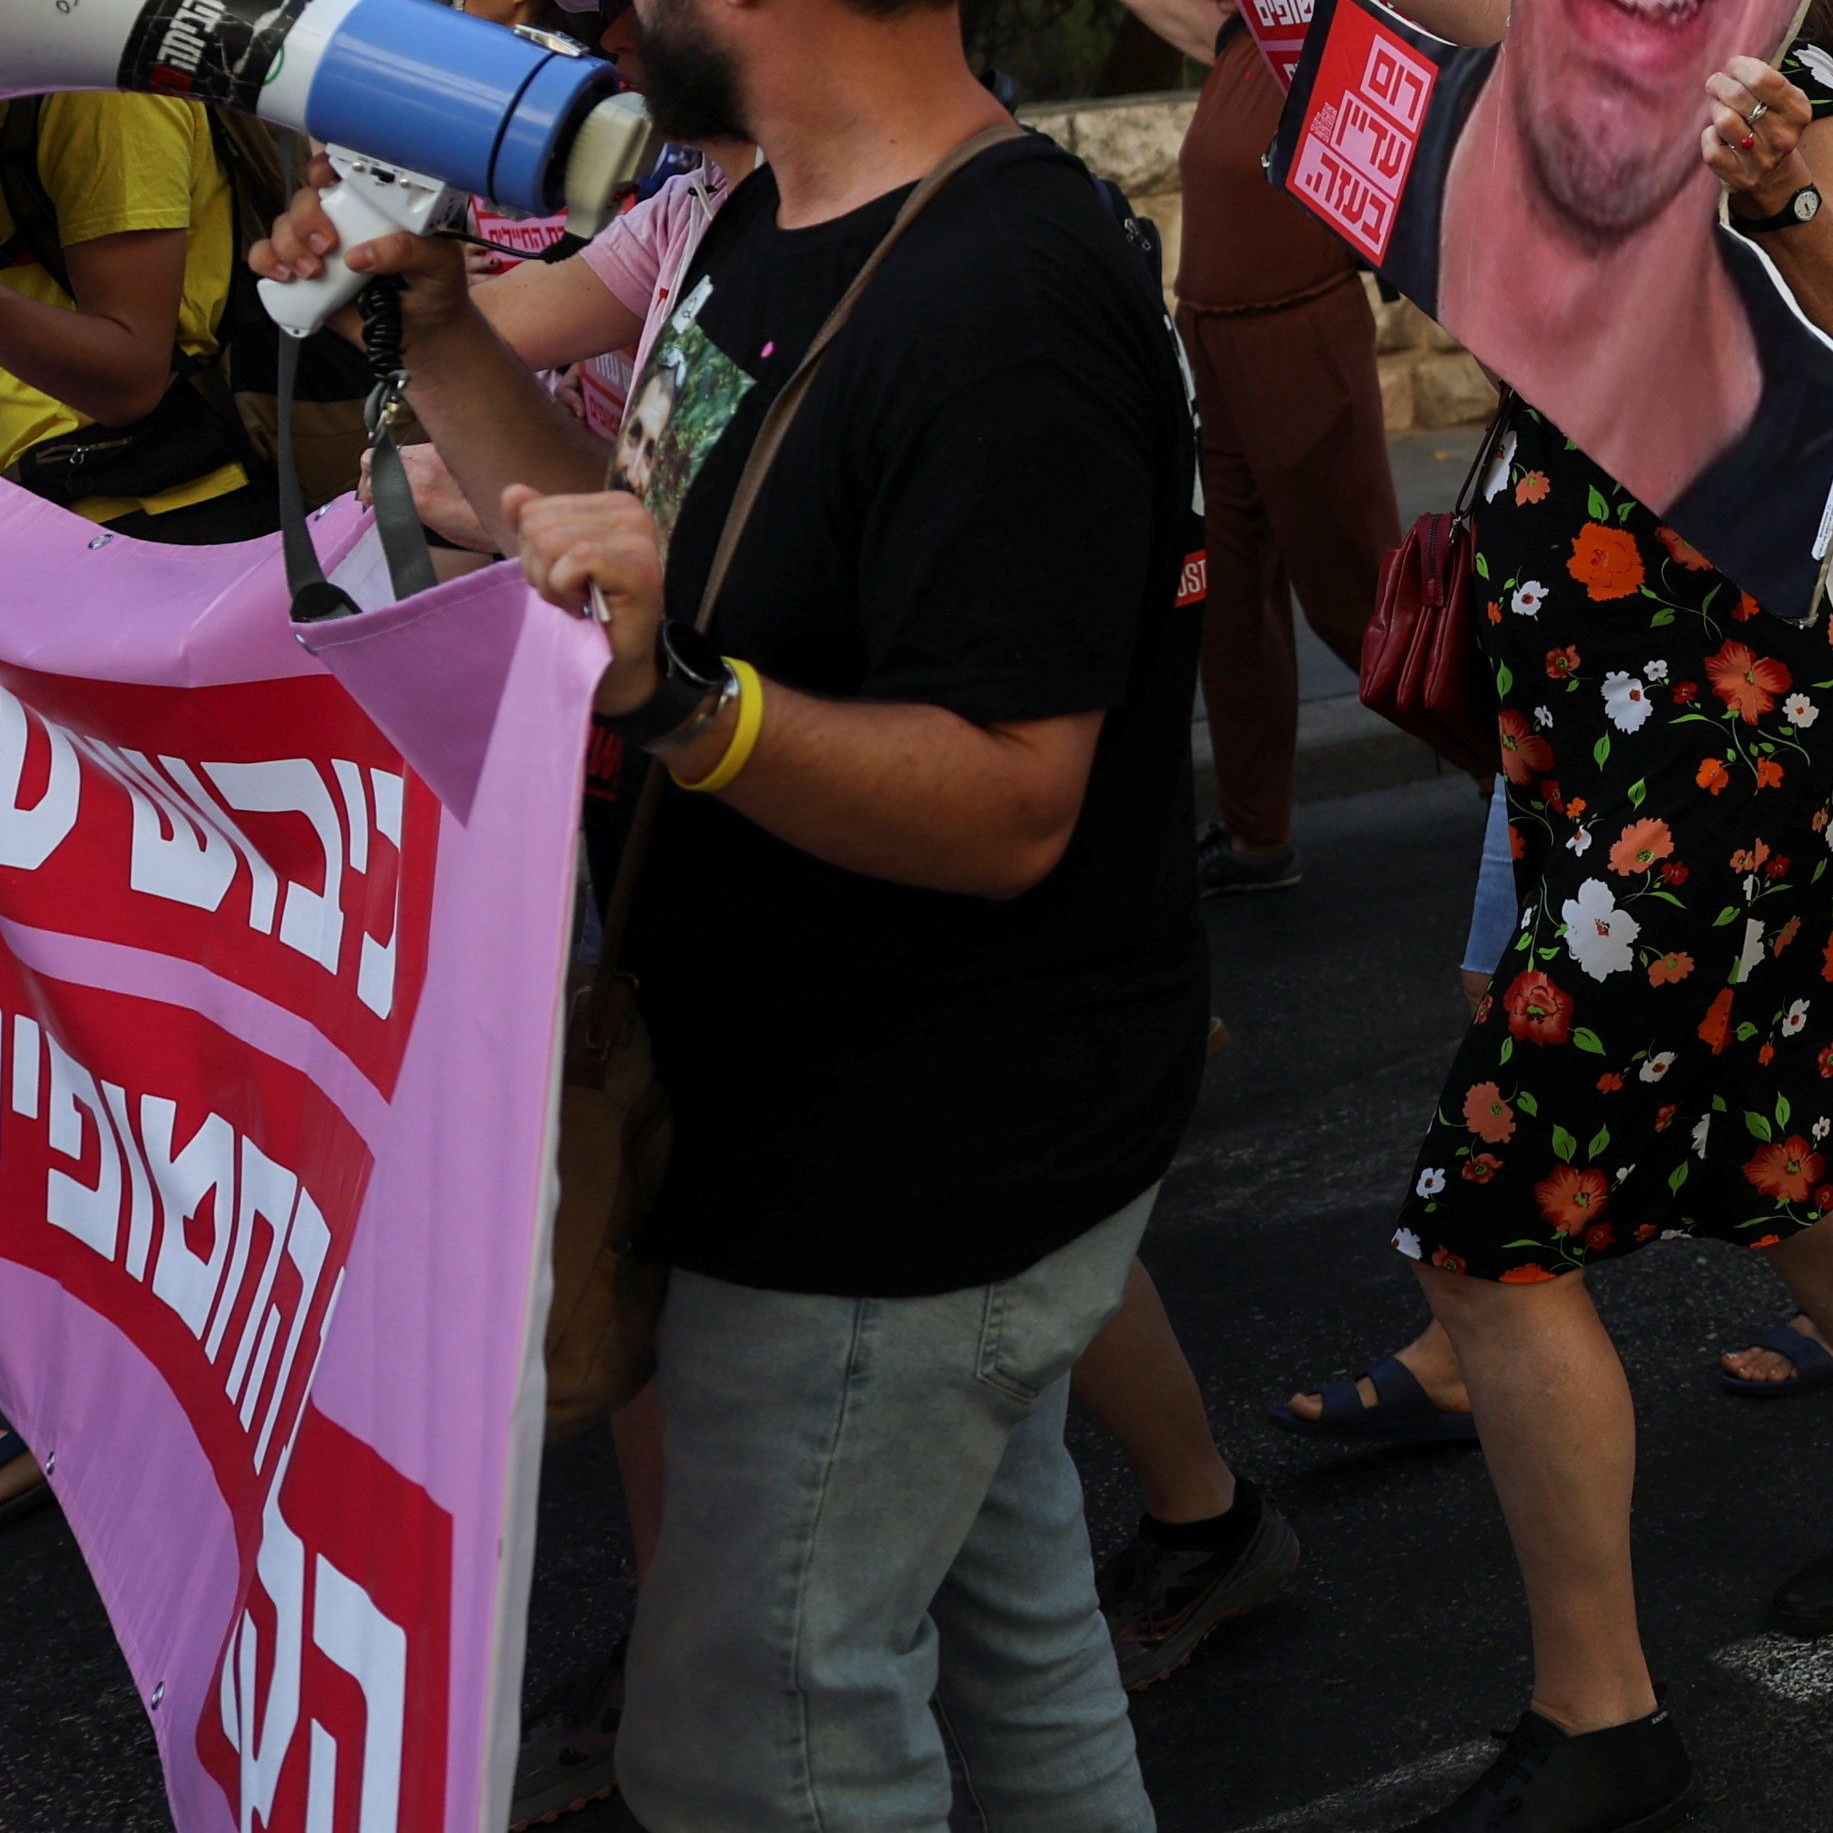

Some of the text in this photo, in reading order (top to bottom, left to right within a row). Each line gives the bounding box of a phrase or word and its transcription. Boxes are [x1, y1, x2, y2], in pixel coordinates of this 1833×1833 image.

[1368, 48, 1424, 121] רום
[1336, 98, 1407, 179] עדיין
[1305, 152, 1387, 246] בעזה.
[52, 722, 404, 1020] כיבוש
[0, 1010, 332, 1476] החטופי
